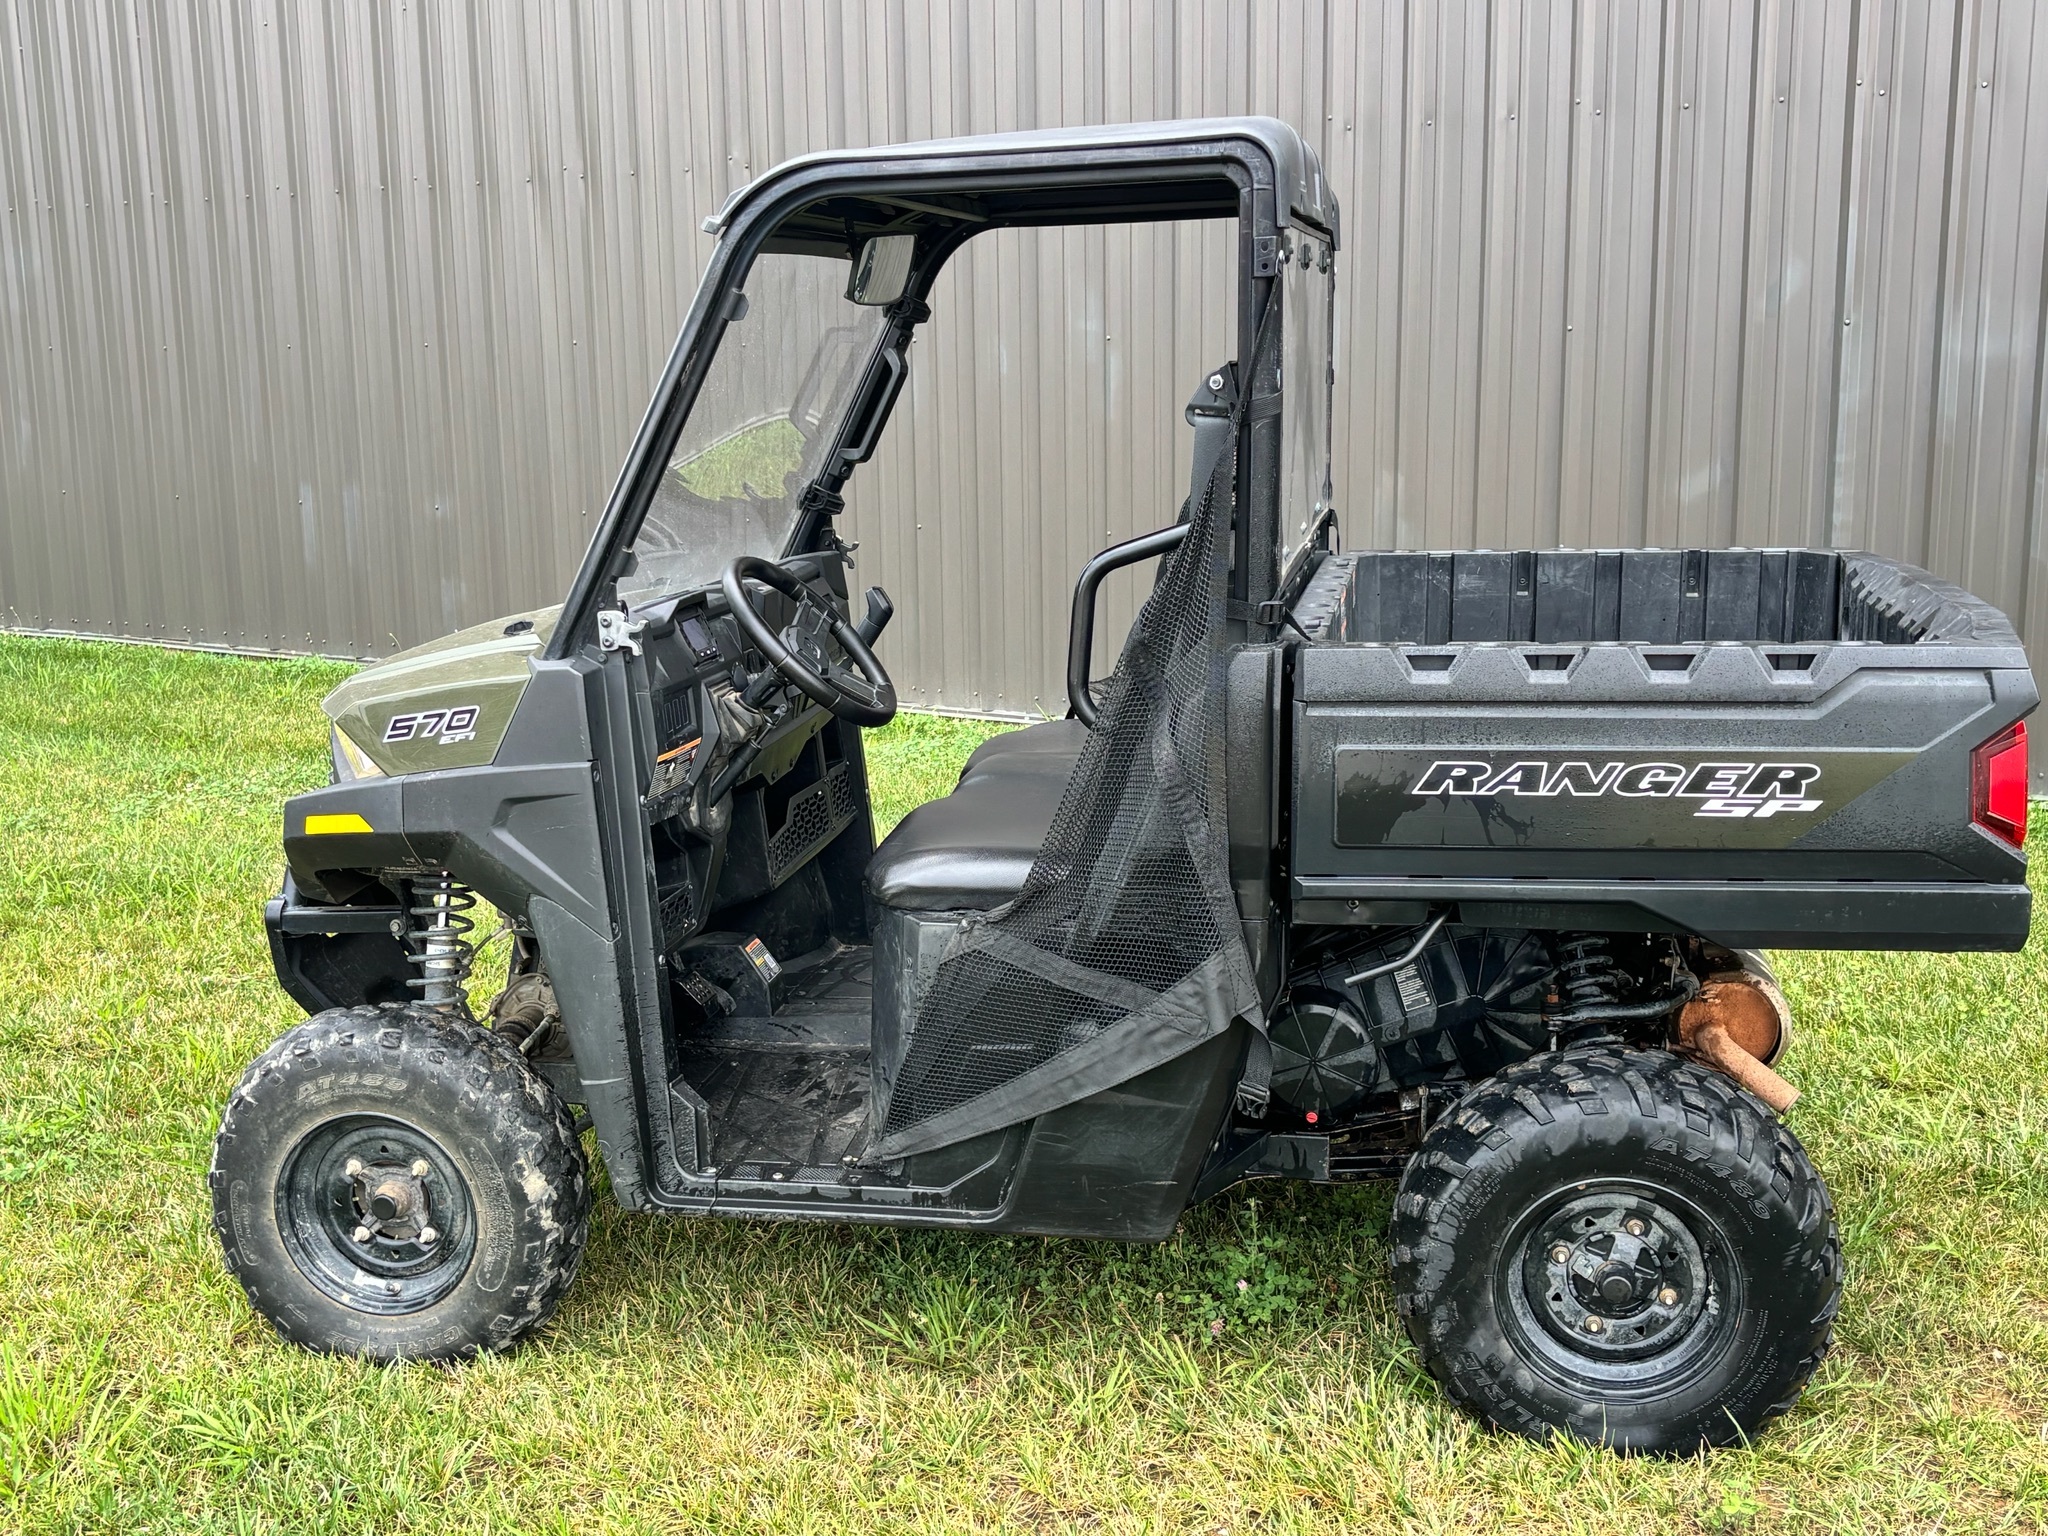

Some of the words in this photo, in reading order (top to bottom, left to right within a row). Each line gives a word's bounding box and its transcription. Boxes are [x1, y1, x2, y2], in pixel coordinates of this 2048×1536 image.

[382, 705, 480, 743] 570
[438, 732, 476, 744] EFI
[1412, 761, 1823, 798] RANGER
[1693, 799, 1824, 818] SP
[297, 1072, 408, 1101] AT489
[1649, 1136, 1771, 1220] AT489
